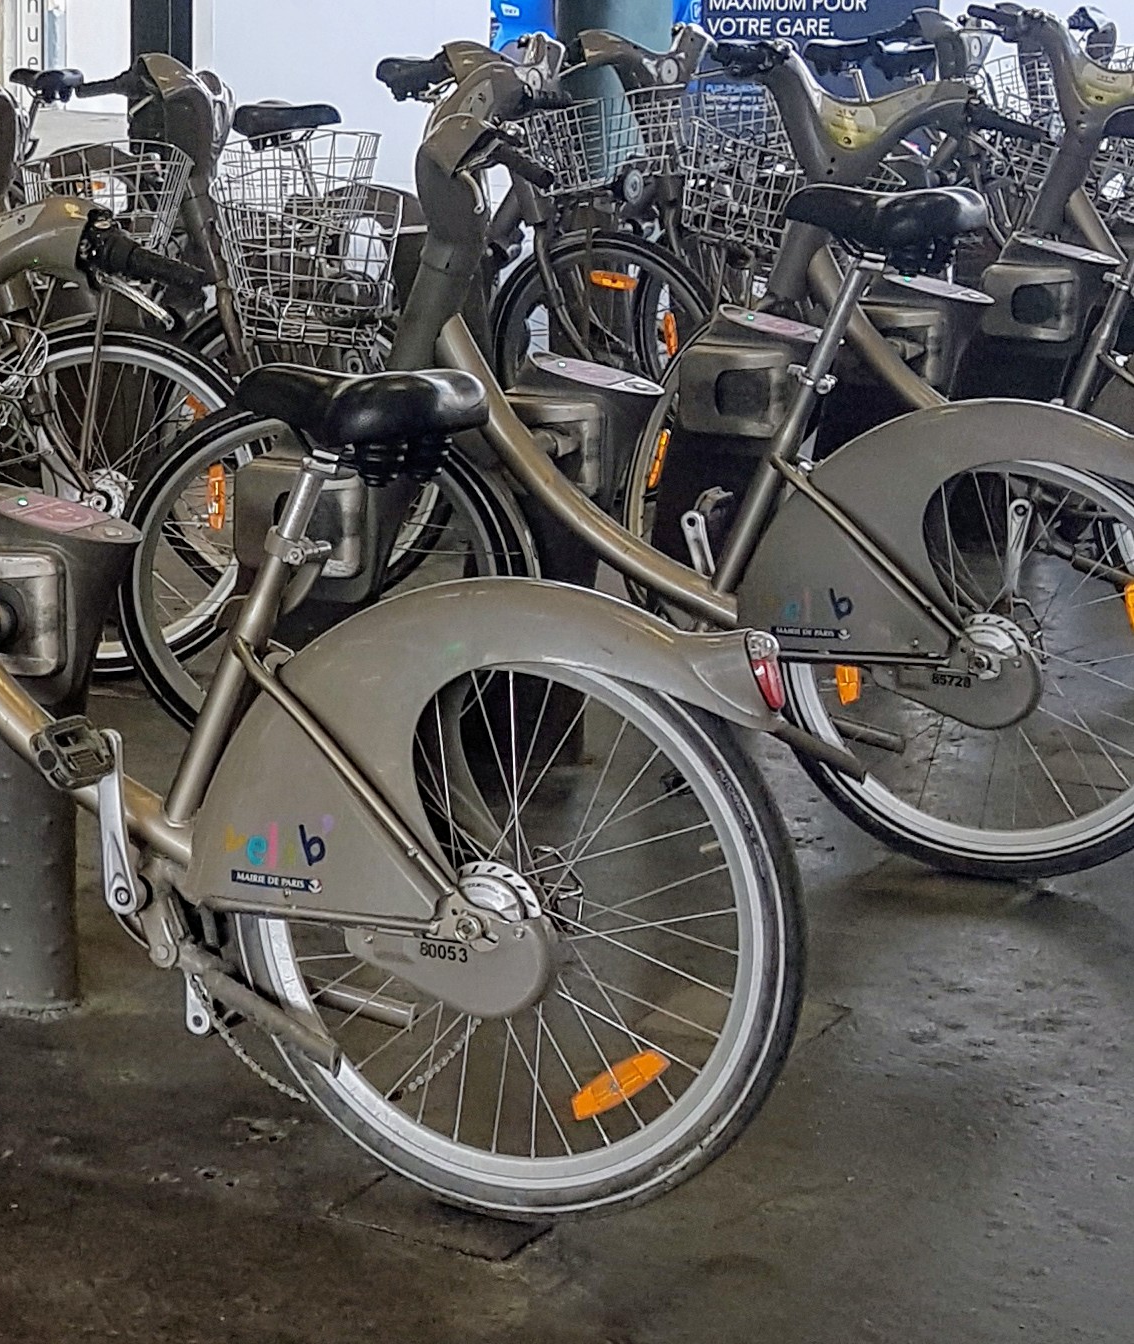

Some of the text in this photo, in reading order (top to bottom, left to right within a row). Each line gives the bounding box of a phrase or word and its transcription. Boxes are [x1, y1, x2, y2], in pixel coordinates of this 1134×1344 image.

[707, 18, 835, 37] VOTRE GARE.
[235, 871, 305, 889] MAIRIE DE PARIS
